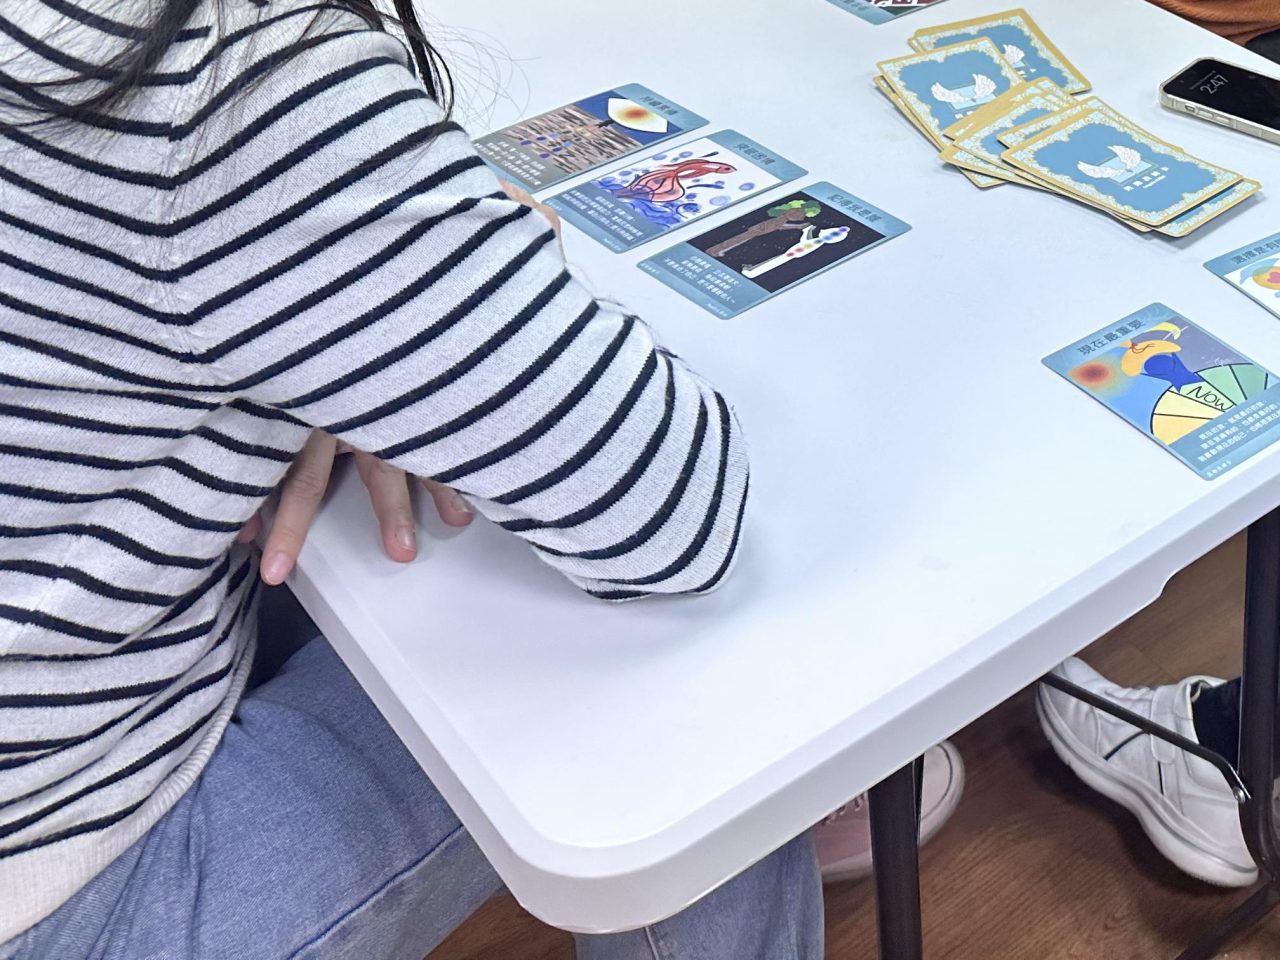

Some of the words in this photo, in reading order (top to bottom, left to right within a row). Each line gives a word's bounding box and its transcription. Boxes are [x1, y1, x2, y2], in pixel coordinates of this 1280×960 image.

[1199, 74, 1228, 95] 2:47
[1076, 318, 1146, 356] 現在最重要
[1186, 385, 1236, 411] NOW
